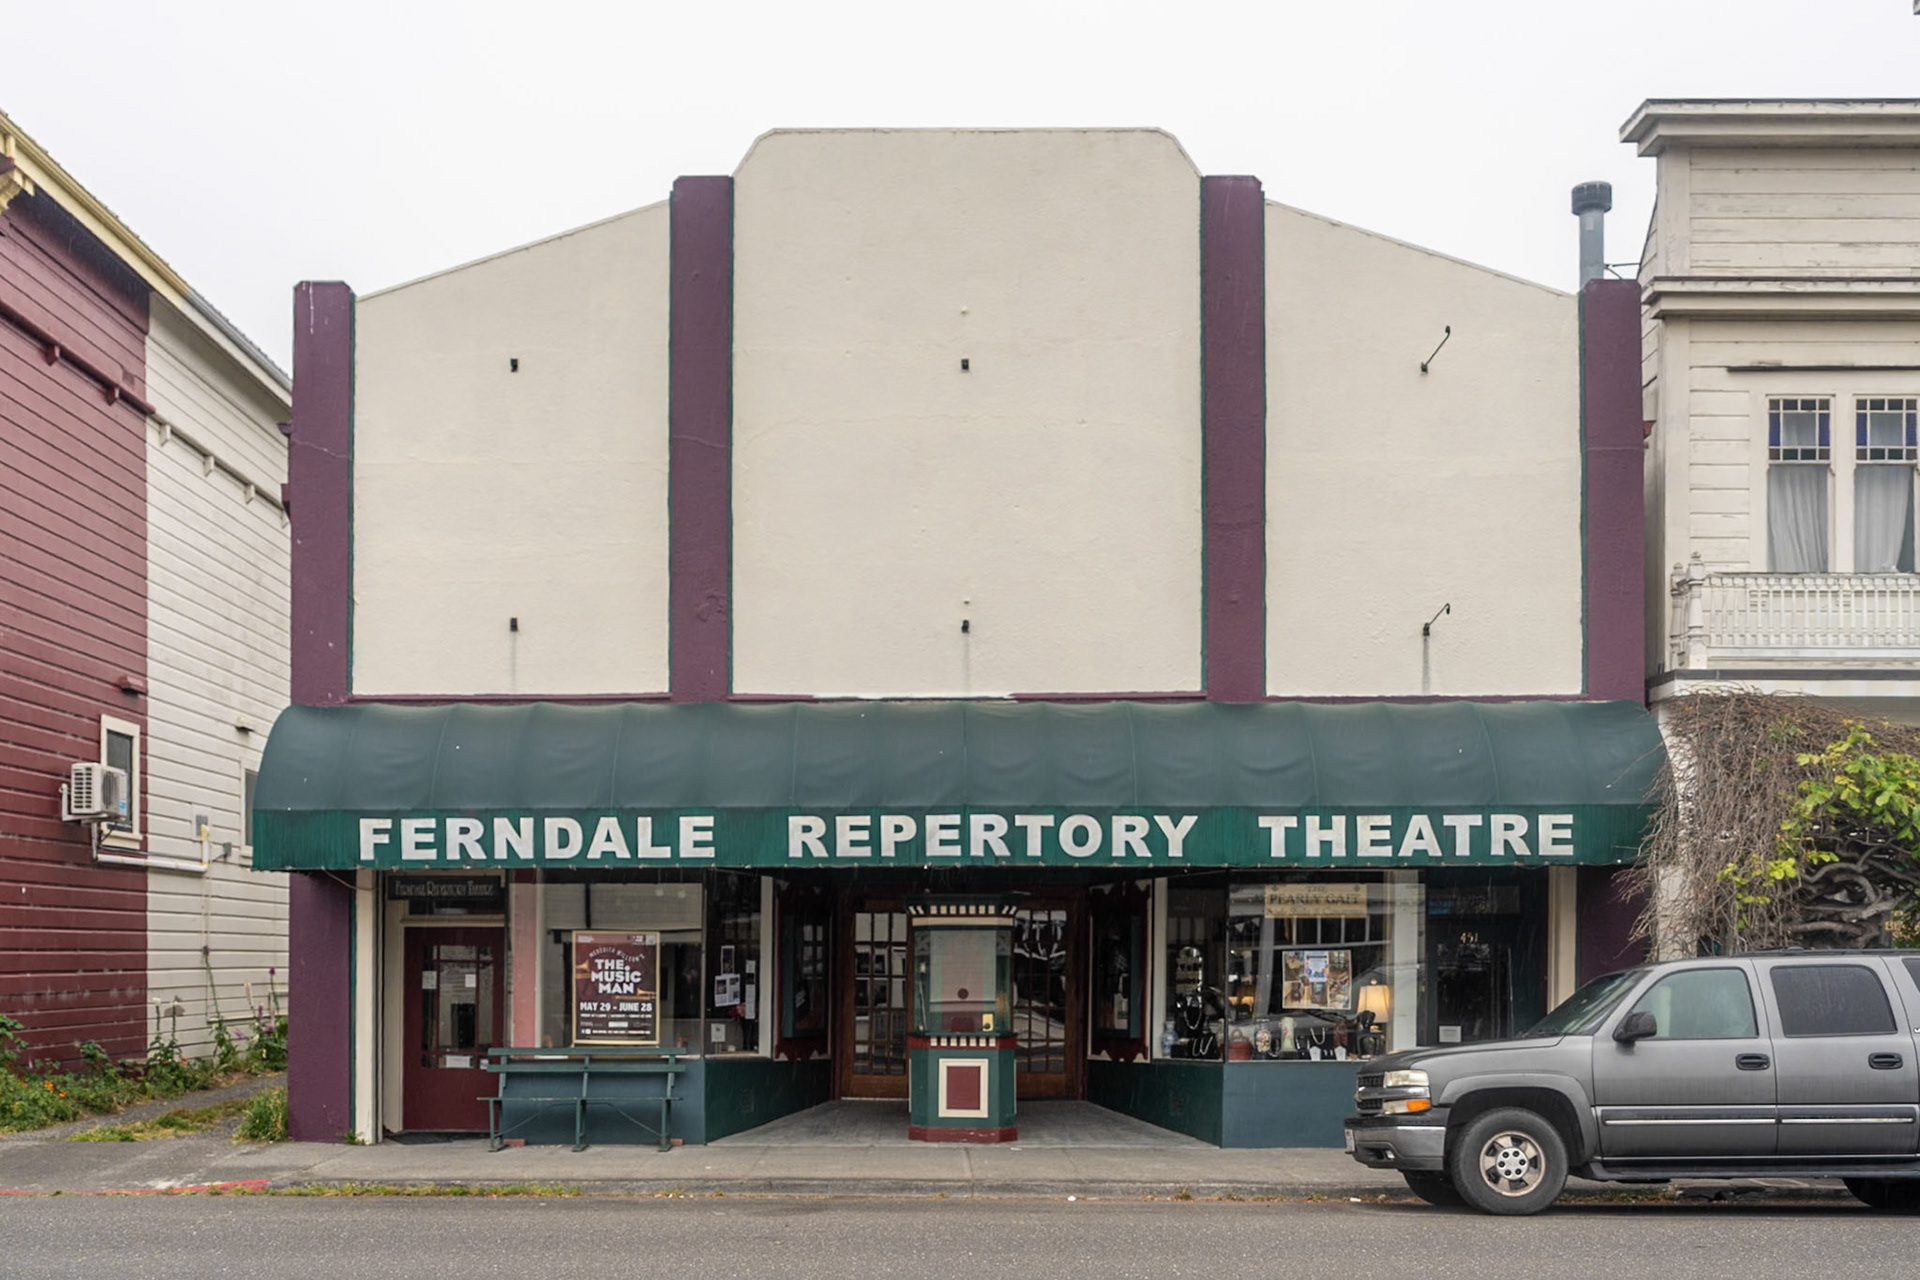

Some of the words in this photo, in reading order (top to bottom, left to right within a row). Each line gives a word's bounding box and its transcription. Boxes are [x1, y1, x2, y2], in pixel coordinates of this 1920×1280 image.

[359, 816, 715, 860] FERNDALE
[788, 814, 1198, 858] REPERTORY
[1258, 814, 1574, 858] THEATRE
[594, 959, 625, 970] THE
[598, 982, 634, 994] MAN
[580, 1001, 598, 1011] MAY
[600, 1002, 611, 1011] 29
[619, 1002, 639, 1012] JUNE
[641, 1003, 652, 1012] 28
